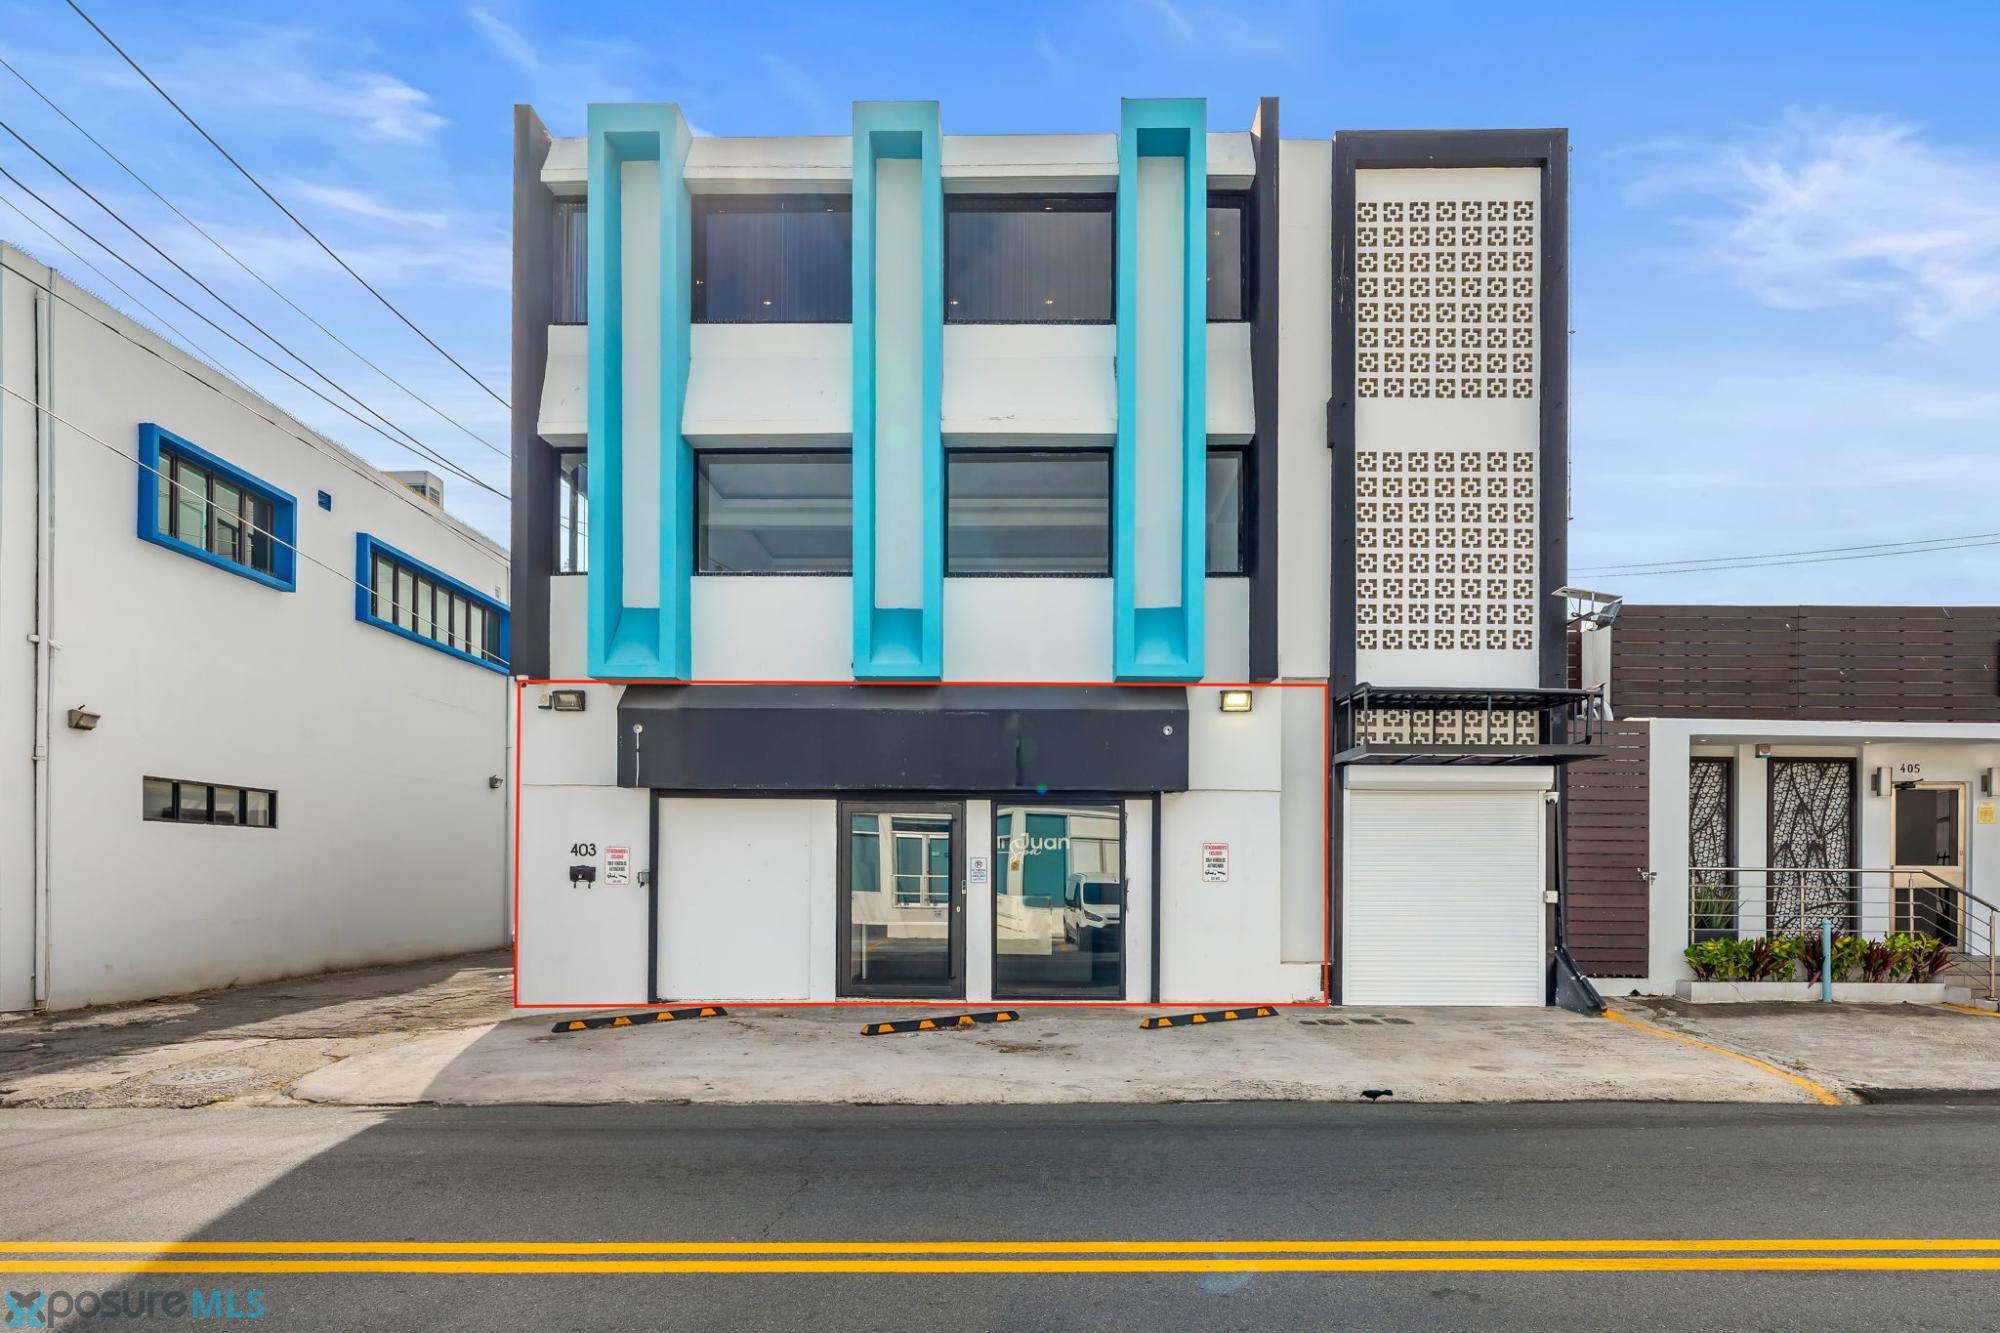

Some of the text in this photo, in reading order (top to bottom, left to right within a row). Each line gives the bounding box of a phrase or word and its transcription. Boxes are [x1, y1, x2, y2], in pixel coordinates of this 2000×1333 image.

[1900, 763, 1921, 774] 405
[1014, 832, 1070, 850] Juan
[570, 843, 597, 857] 403
